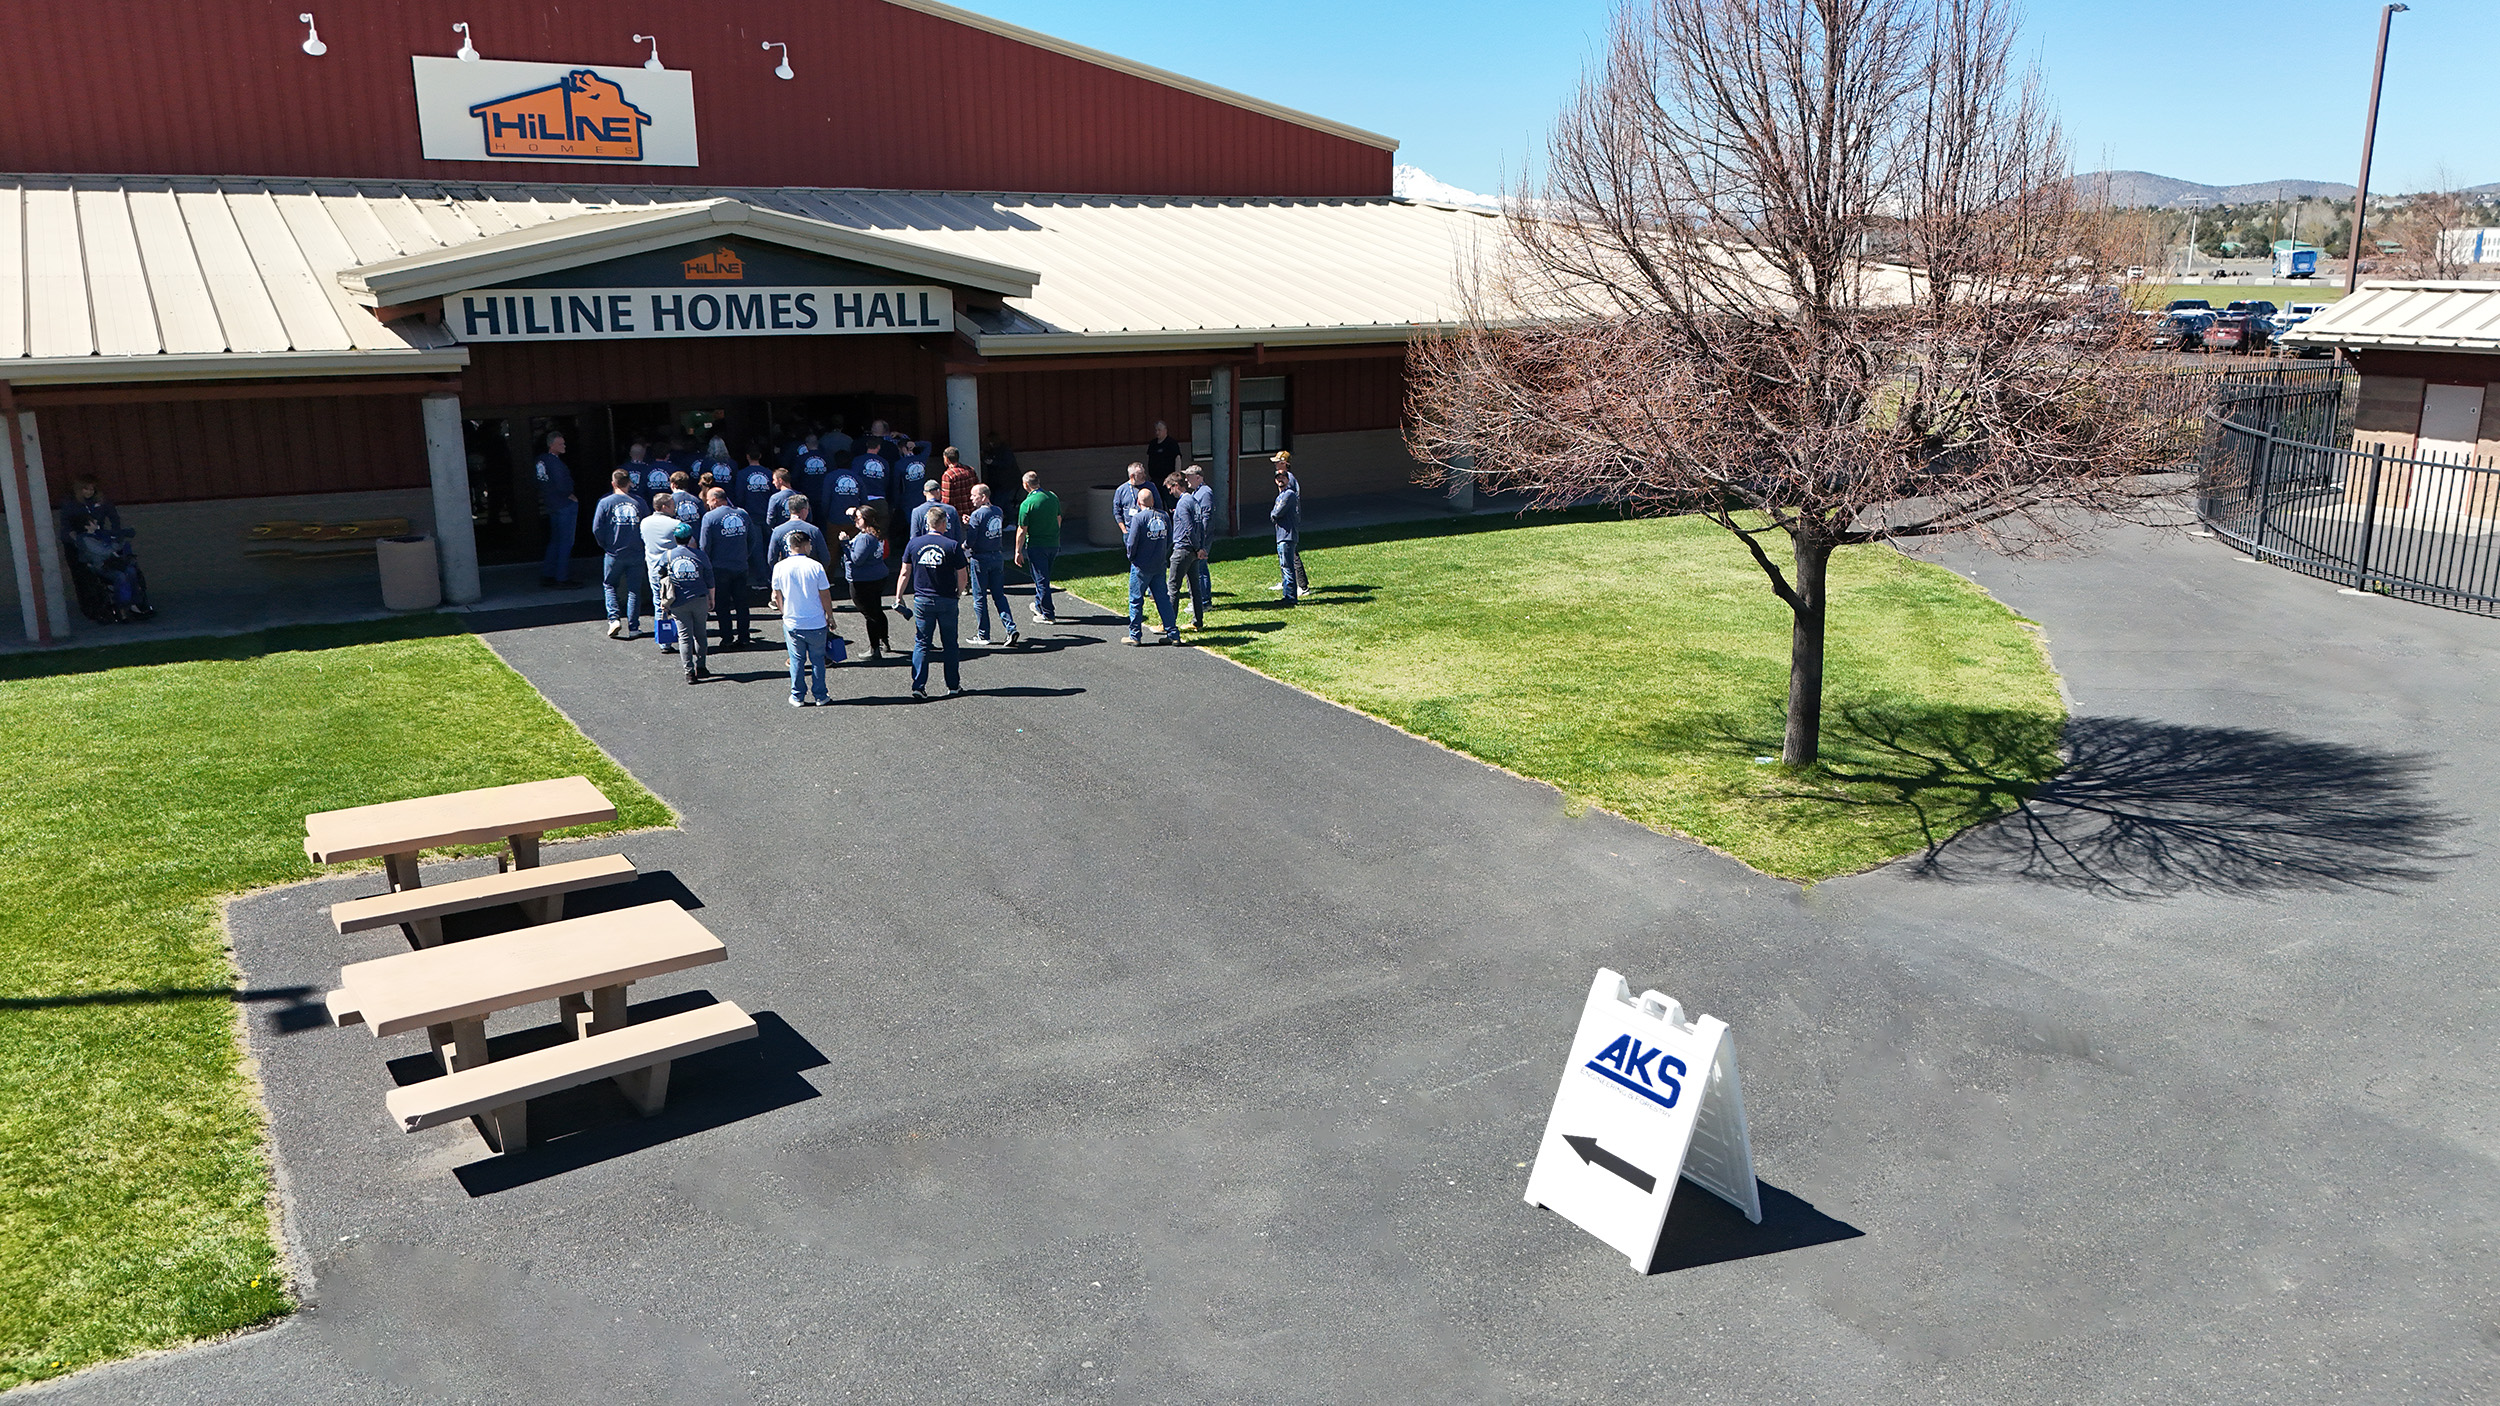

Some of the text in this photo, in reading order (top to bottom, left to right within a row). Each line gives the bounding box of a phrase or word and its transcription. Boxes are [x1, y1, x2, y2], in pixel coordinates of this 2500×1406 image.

[495, 142, 634, 155] HOMES
[463, 292, 940, 335] HILINE HOMES HALL
[1580, 1067, 1627, 1097] ENGINEERING
[1585, 1033, 1687, 1109] AKS
